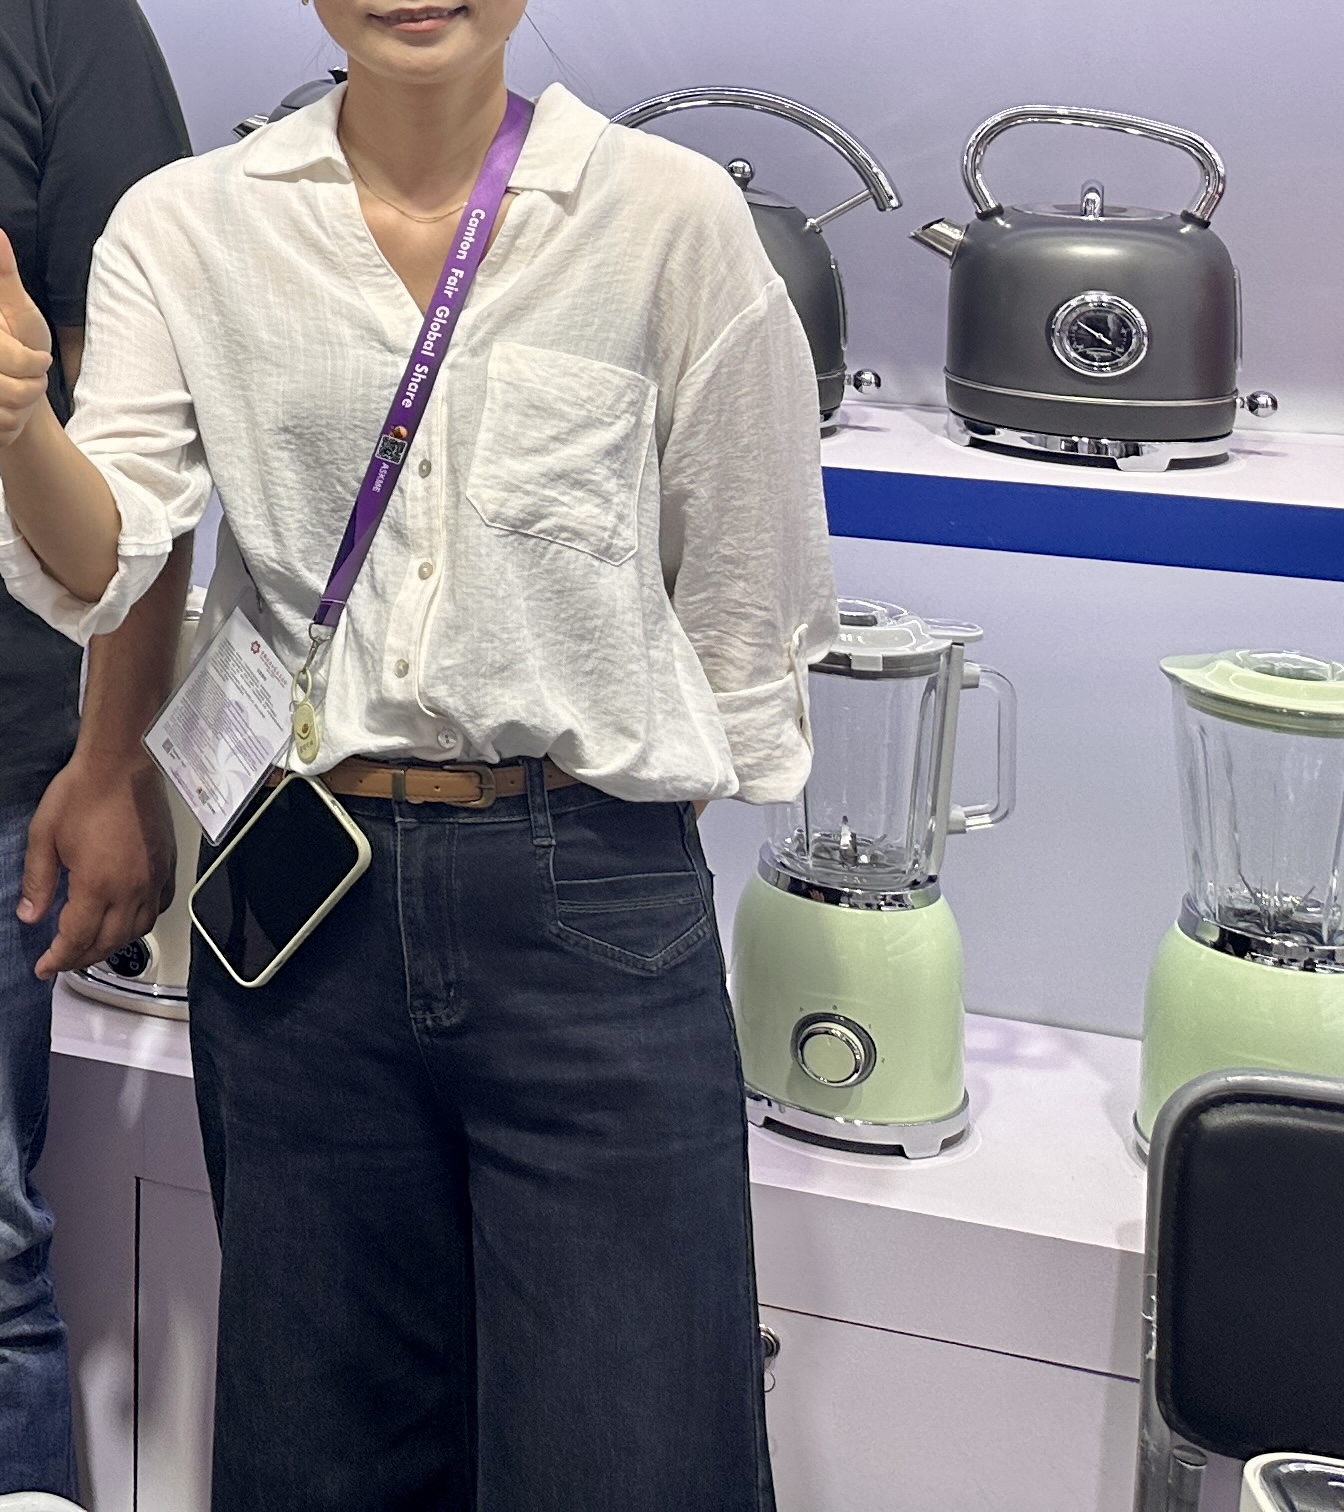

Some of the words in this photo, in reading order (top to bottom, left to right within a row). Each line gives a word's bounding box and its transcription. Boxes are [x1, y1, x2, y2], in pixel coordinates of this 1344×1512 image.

[456, 208, 486, 260] Canton
[443, 267, 465, 299] Fair
[421, 305, 450, 357] Global
[401, 363, 429, 409] Share
